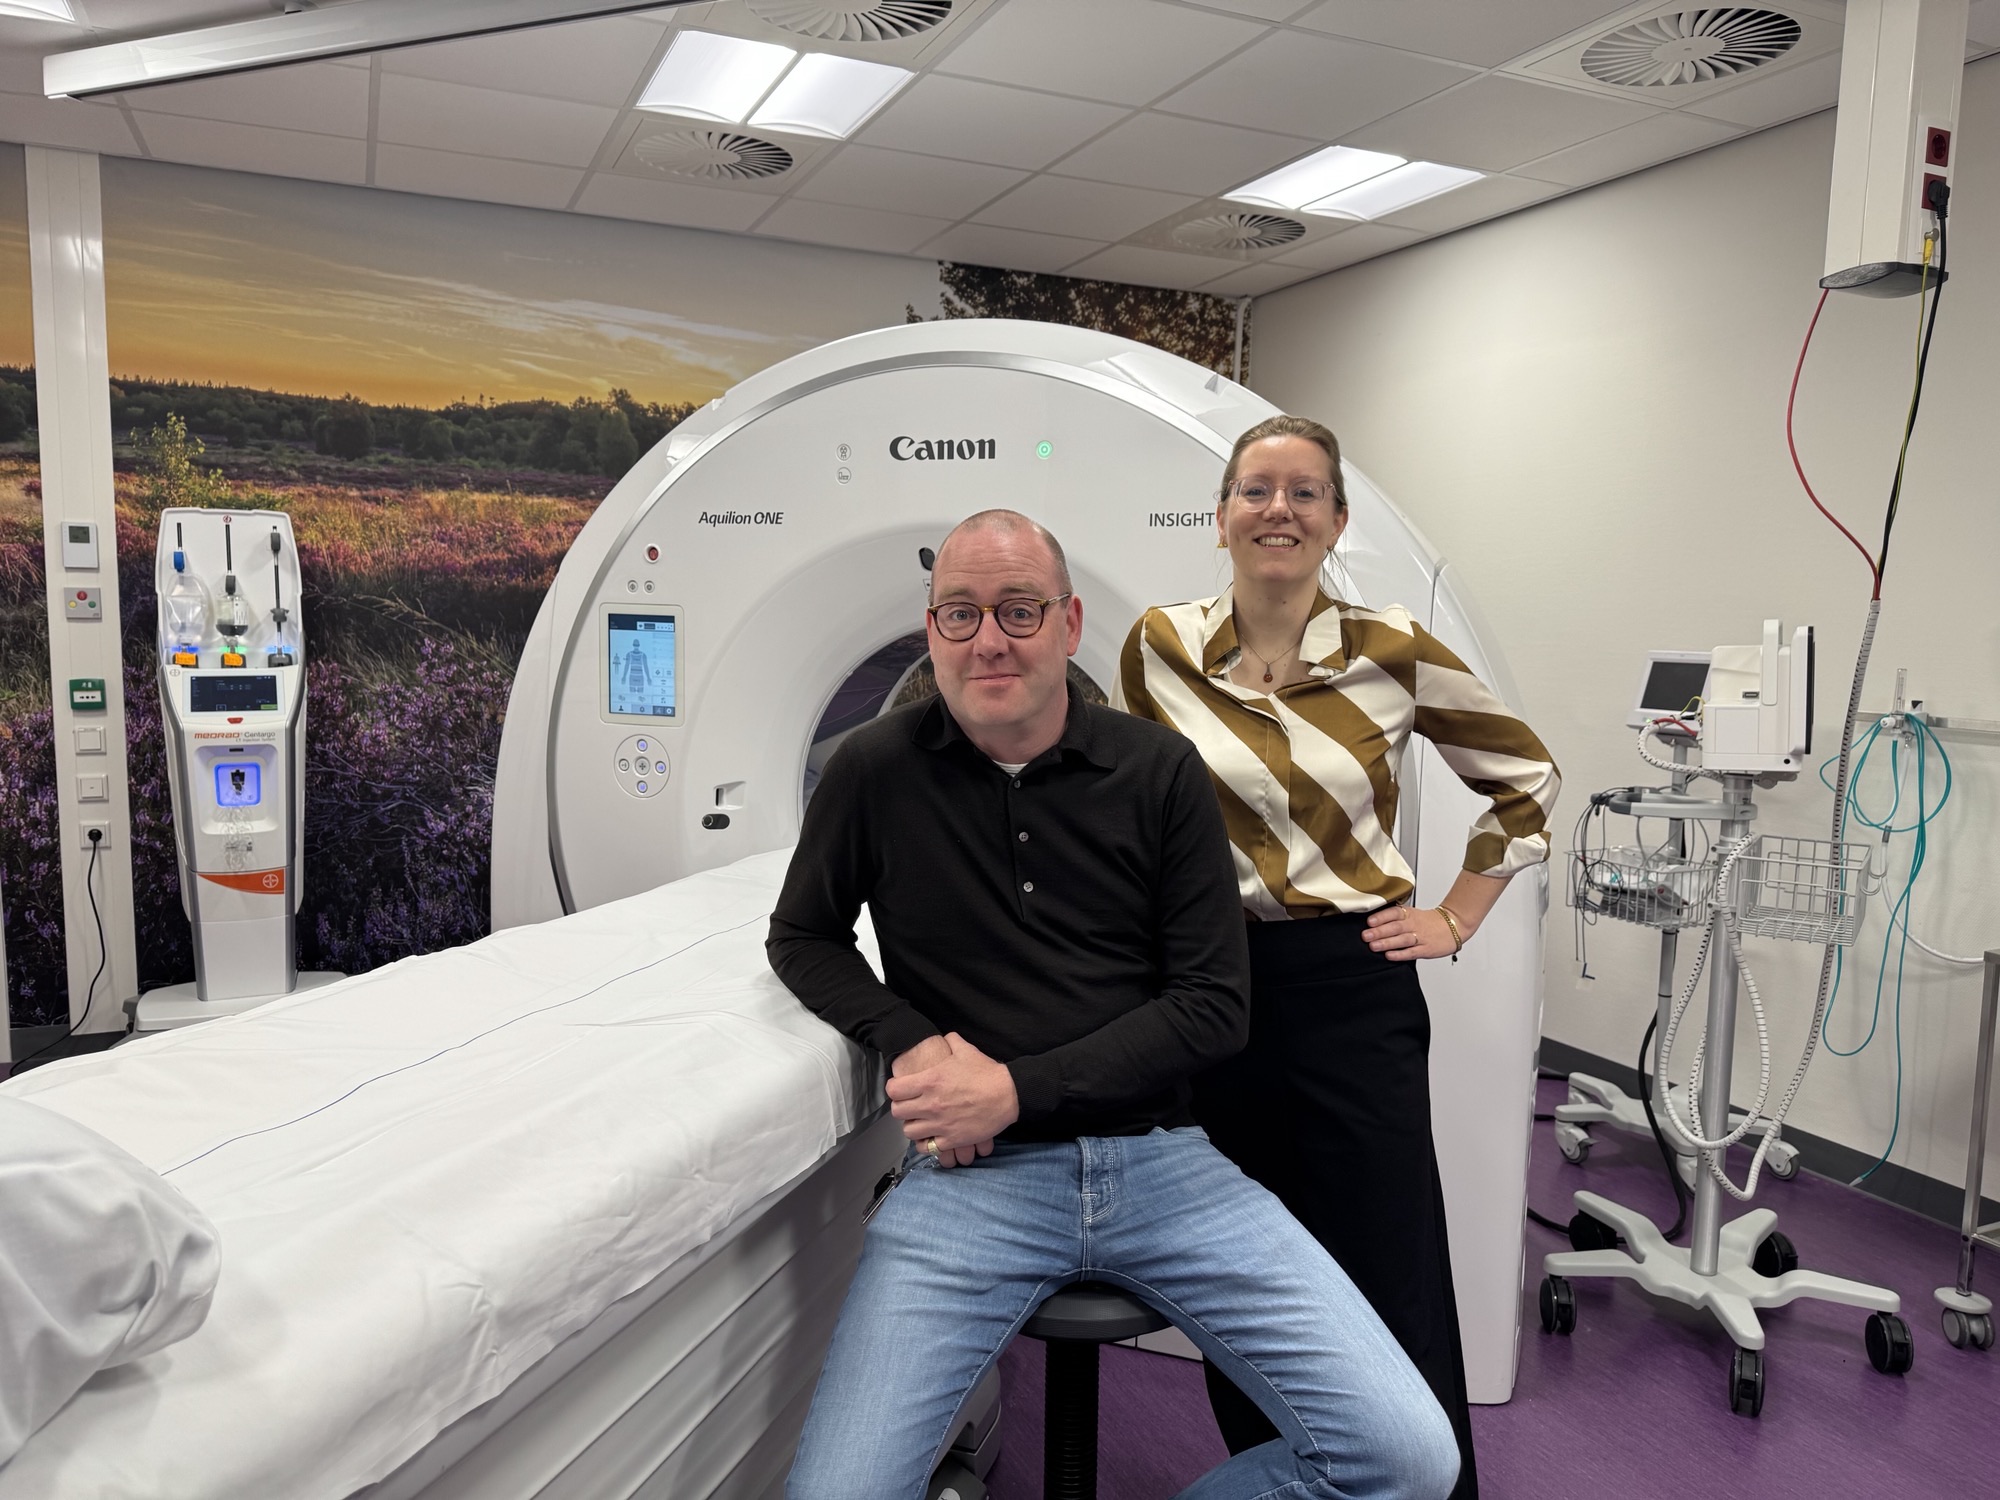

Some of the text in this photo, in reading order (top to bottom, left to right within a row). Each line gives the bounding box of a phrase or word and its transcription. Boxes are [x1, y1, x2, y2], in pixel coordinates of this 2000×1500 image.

[889, 435, 996, 461] Canon
[698, 511, 784, 528] Aquilion ONE
[1149, 512, 1216, 527] INSIGHT
